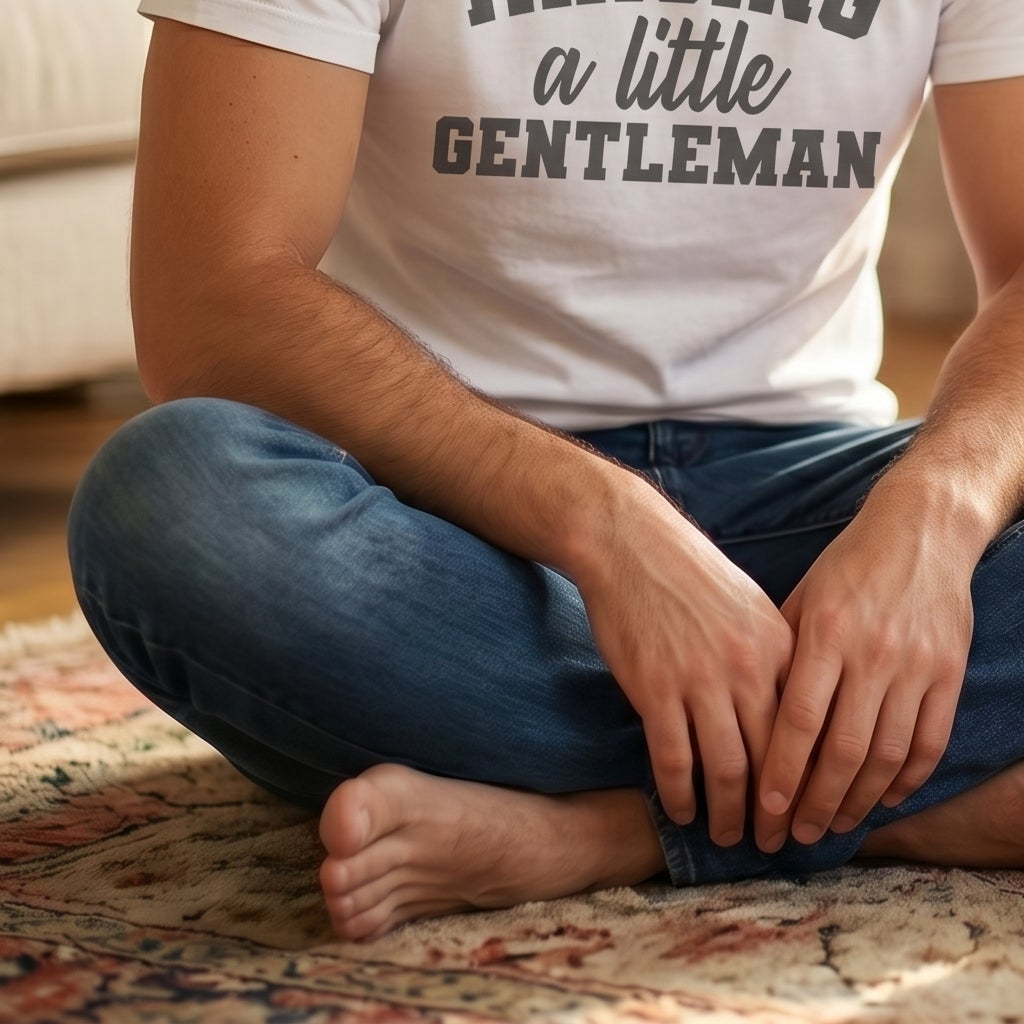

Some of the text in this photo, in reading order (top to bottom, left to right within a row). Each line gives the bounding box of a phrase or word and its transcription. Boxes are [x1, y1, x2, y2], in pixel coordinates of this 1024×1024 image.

[534, 16, 792, 115] a little
[432, 116, 881, 188] GENTLEMAN
